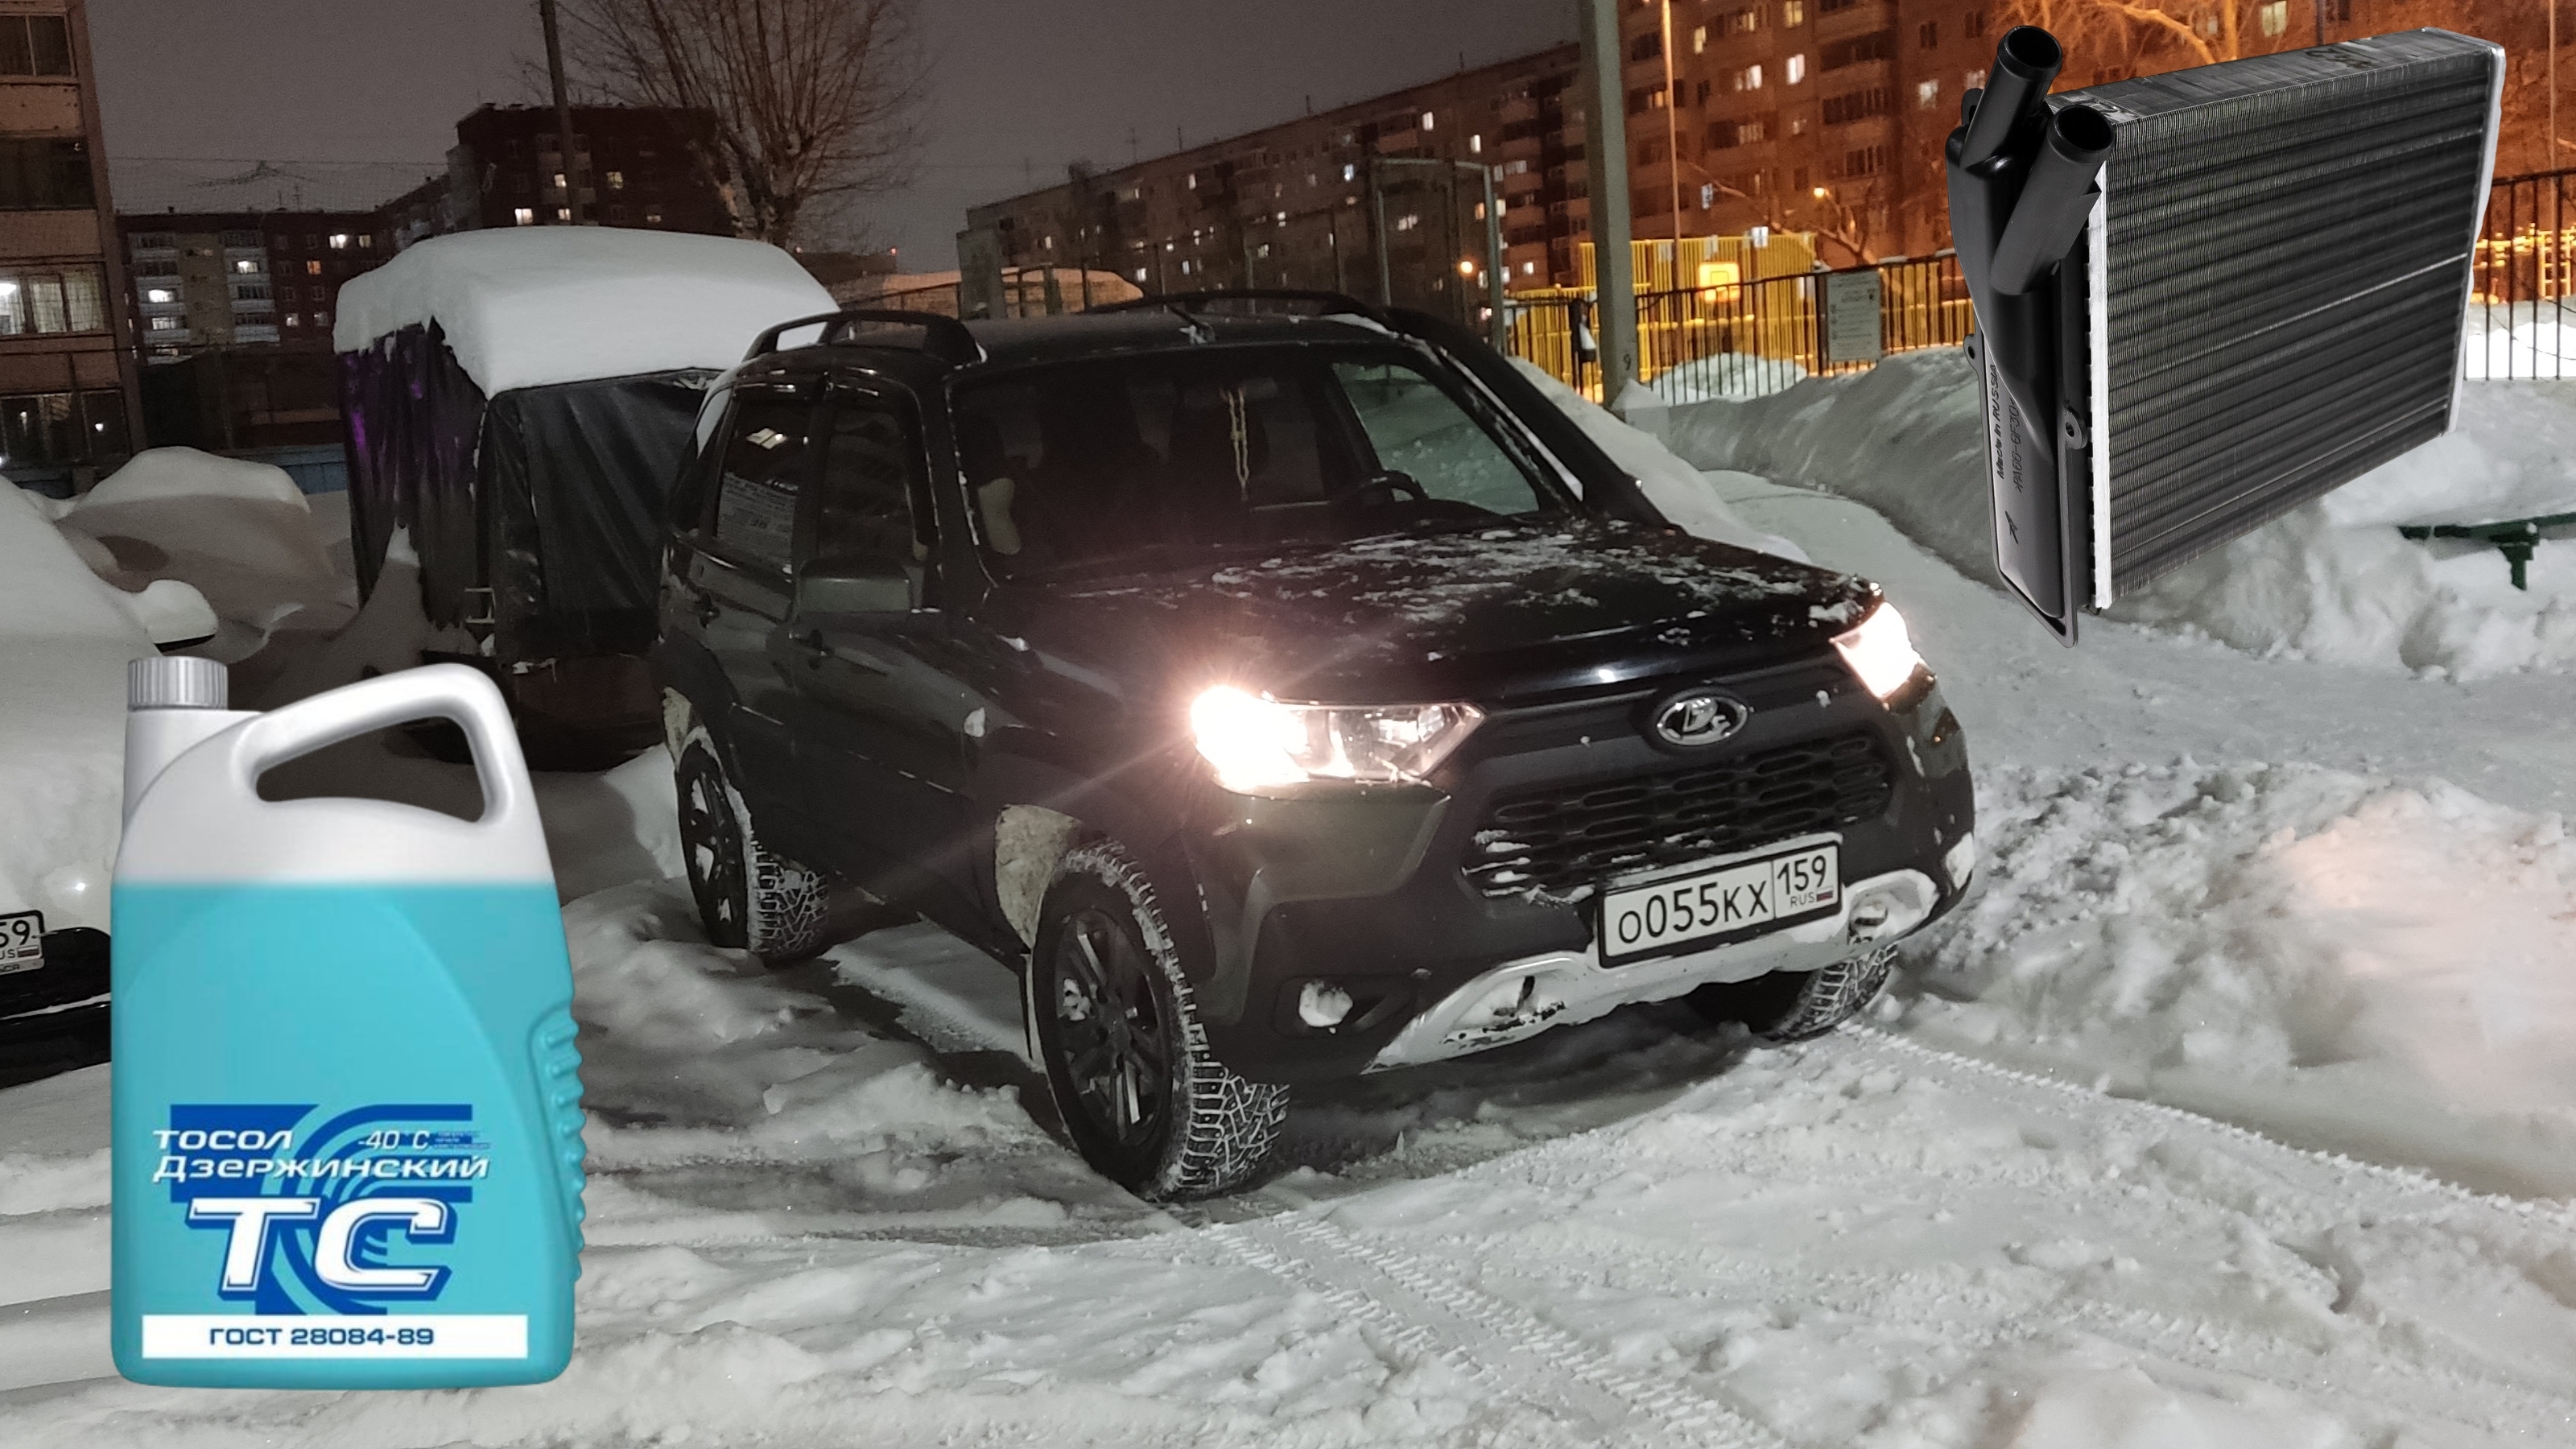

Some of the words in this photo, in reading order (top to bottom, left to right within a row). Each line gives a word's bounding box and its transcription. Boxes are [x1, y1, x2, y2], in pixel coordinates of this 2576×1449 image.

[1989, 364, 2000, 423] RUSSIA
[1777, 855, 1827, 895] 159
[1618, 880, 1769, 943] О055КХ
[1790, 891, 1815, 907] RUS
[152, 1129, 293, 1151] ТОСОЛ
[151, 1154, 489, 1184] Дзержинский
[209, 1328, 283, 1346] ГОСТ
[291, 1328, 436, 1346] 28084-89
